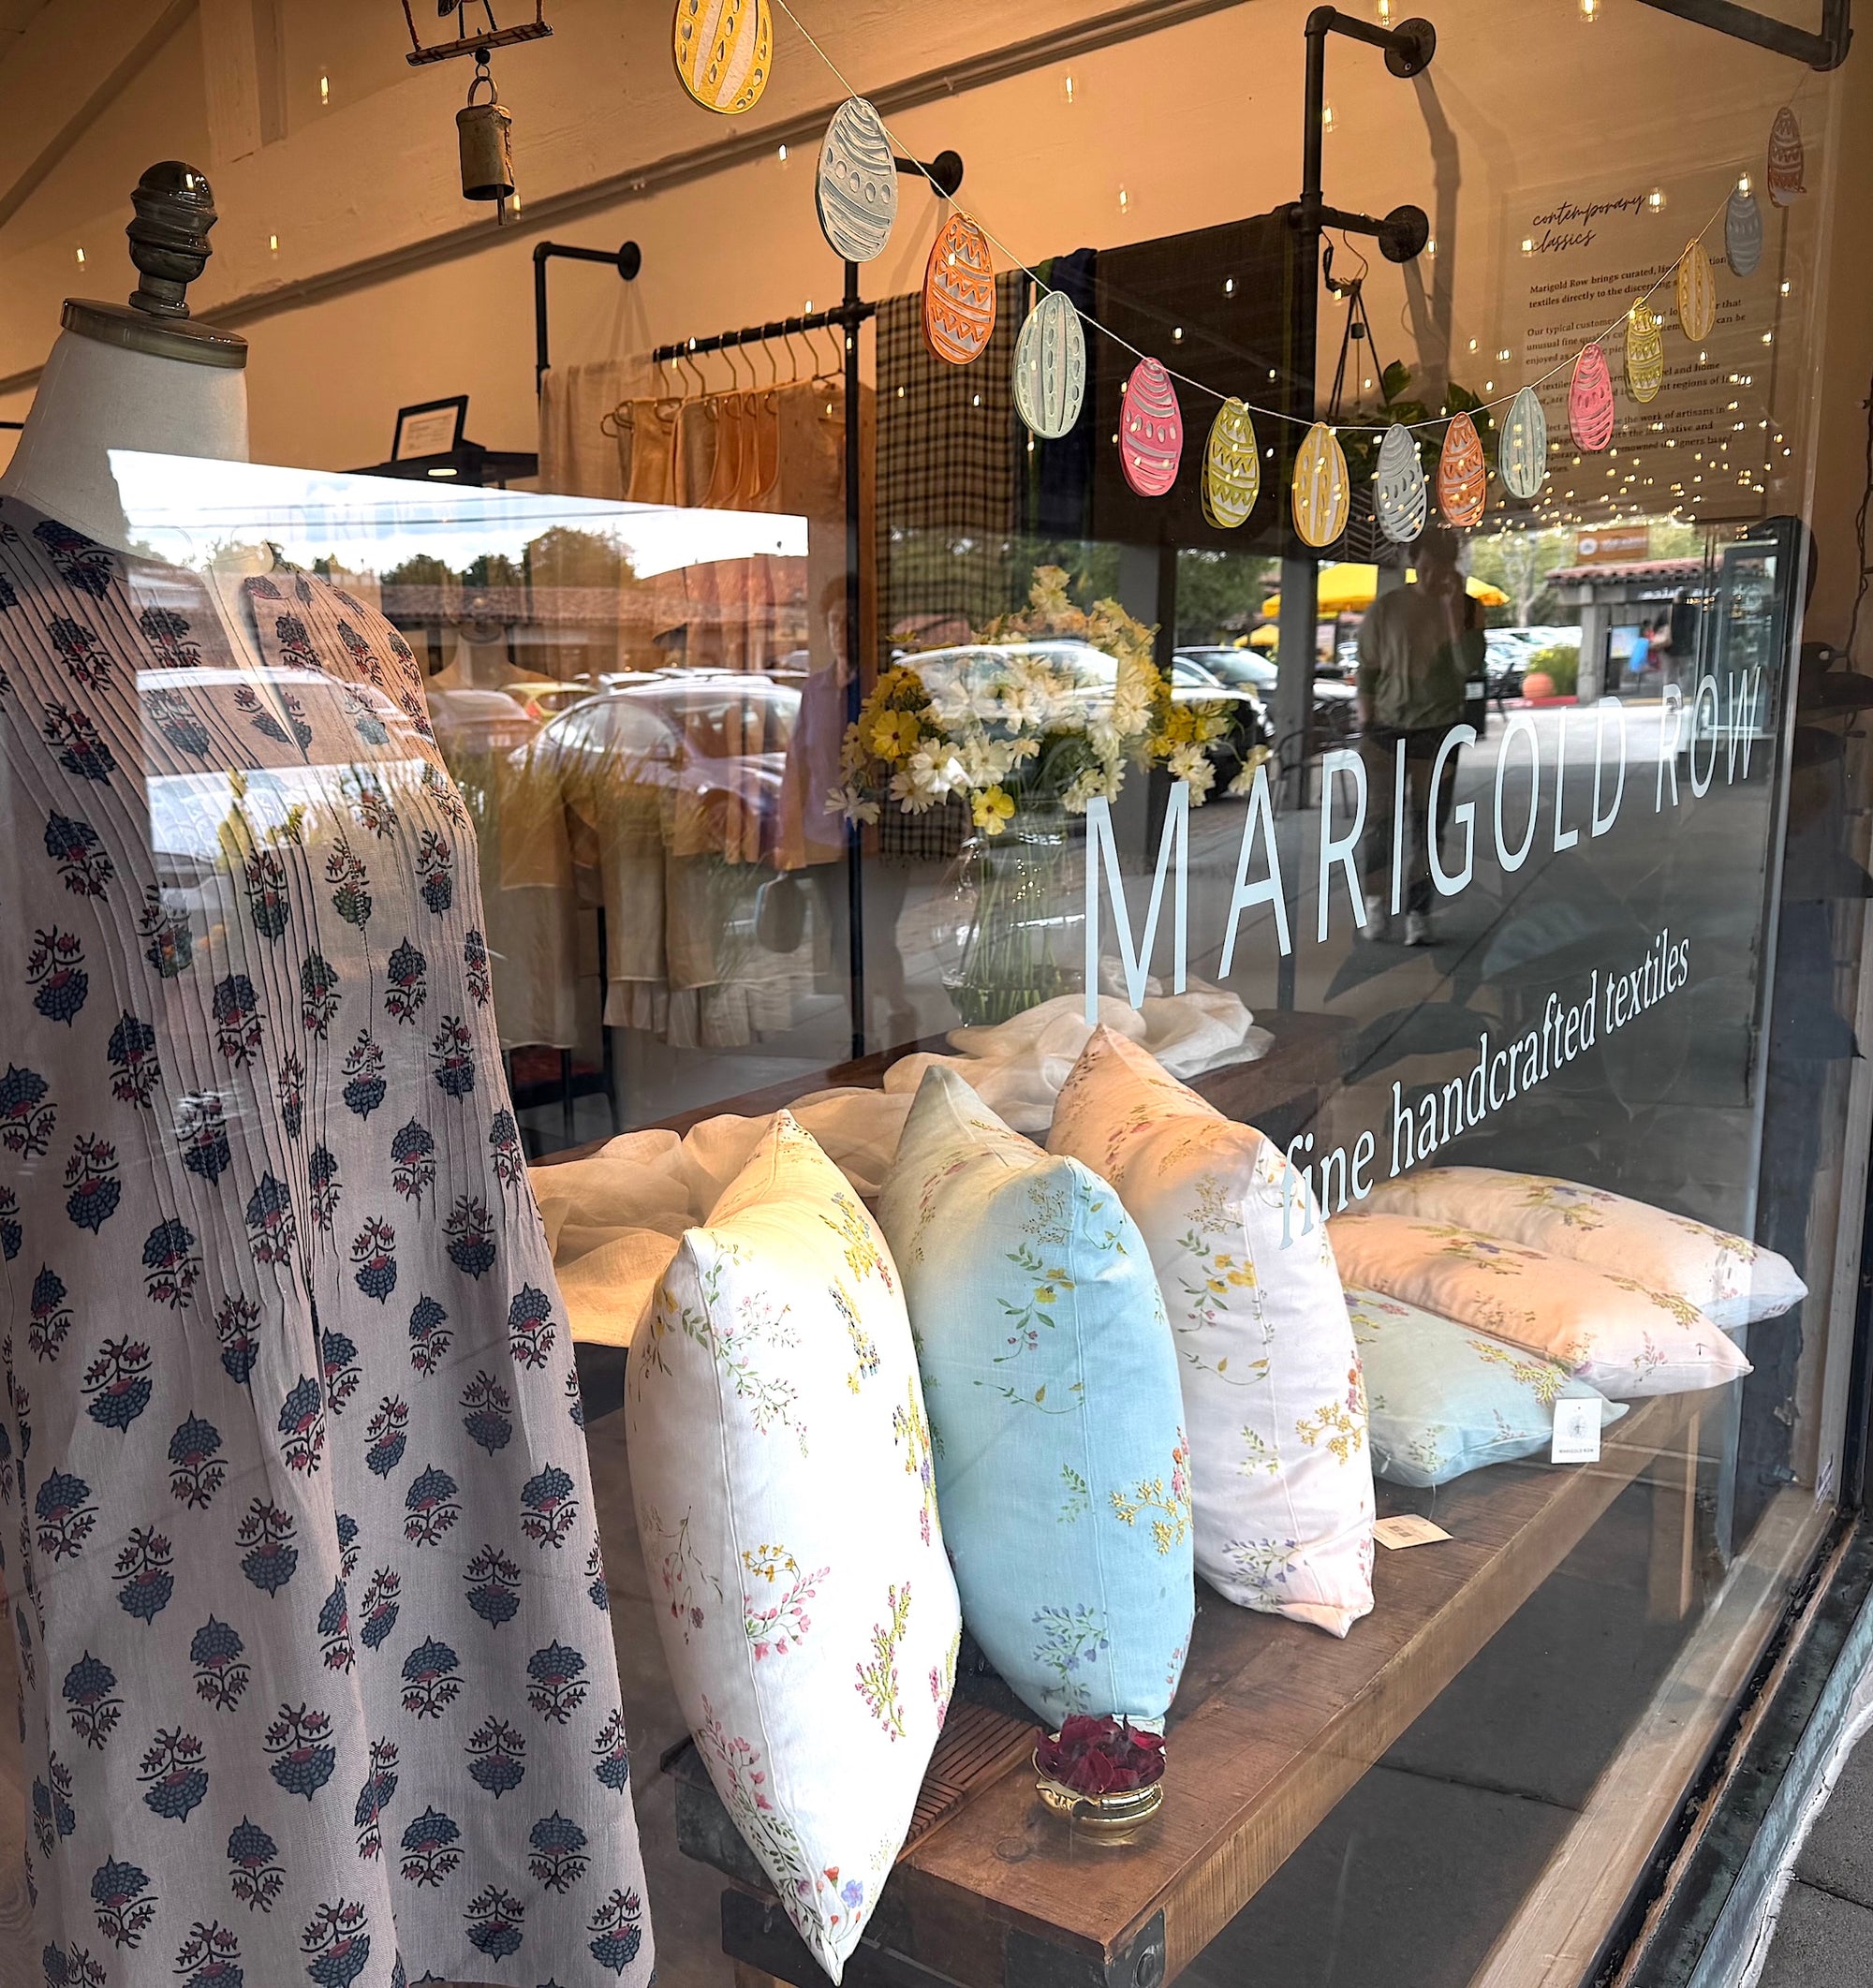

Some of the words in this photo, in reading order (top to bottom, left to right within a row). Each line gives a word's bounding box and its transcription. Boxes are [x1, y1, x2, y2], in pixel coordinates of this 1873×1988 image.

[1530, 280, 1568, 293] Marigold
[1570, 278, 1589, 288] Row
[1591, 272, 1619, 285] brings
[1621, 266, 1657, 280] curated,
[1529, 297, 1559, 309] textiles
[1561, 291, 1595, 303] directly
[1597, 289, 1606, 298] to
[1607, 287, 1623, 296] the
[1527, 328, 1544, 337] Our
[1545, 322, 1574, 335] typical
[1722, 299, 1742, 309] that
[1526, 338, 1559, 351] unusual
[1561, 337, 1578, 346] fine
[1716, 316, 1733, 324] can
[1736, 313, 1746, 321] be
[1526, 352, 1558, 366] enjoyed
[1542, 380, 1571, 391] textile
[1674, 364, 1692, 375] and
[1673, 378, 1705, 390] regions
[1709, 376, 1719, 384] of
[1641, 411, 1662, 421] work
[1664, 409, 1674, 419] of
[1675, 407, 1715, 419] artisans
[1695, 420, 1713, 431] and
[1085, 695, 1626, 1026] MARIGOLD
[1656, 666, 1762, 813] ROW
[1279, 1130, 1375, 1250] fine
[1389, 969, 1598, 1179] handcrafted
[1605, 925, 1689, 1034] textiles
